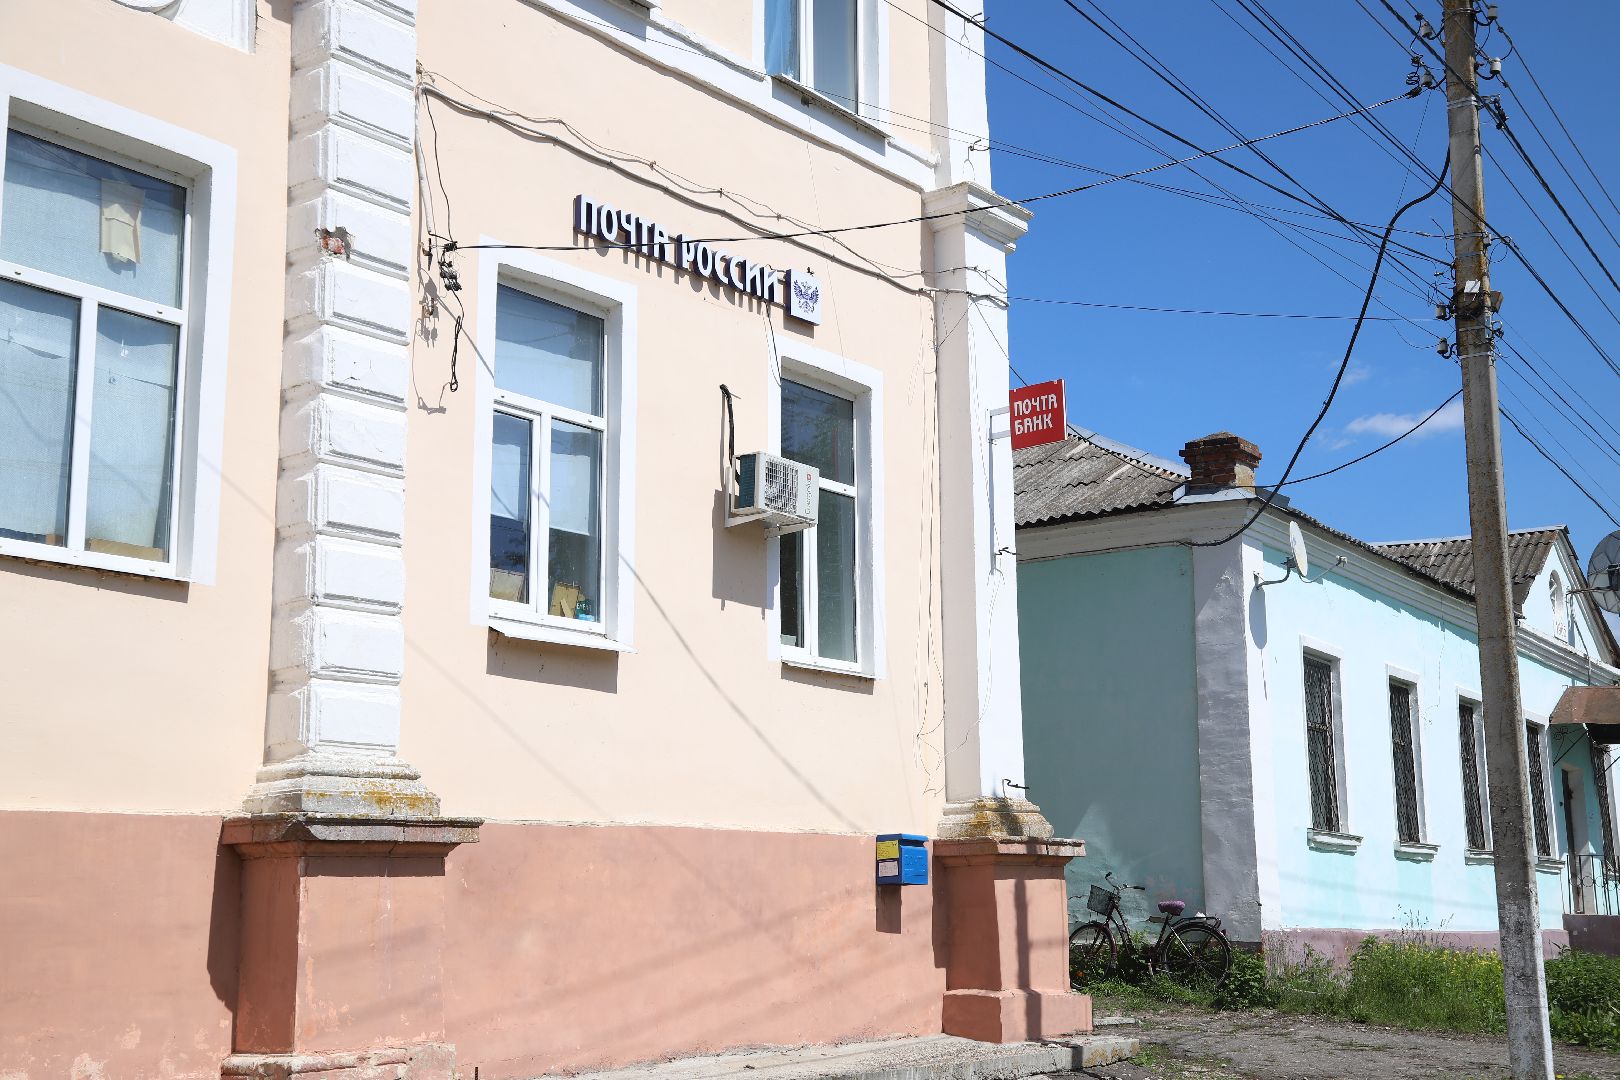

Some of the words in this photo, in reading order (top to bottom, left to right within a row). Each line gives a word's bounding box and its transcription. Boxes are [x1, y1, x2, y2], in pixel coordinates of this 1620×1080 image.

[577, 194, 670, 262] ПОЧТА
[677, 234, 779, 303] РОССИИ
[1014, 394, 1057, 416] ПОЧТА
[1014, 413, 1053, 435] БАНК
